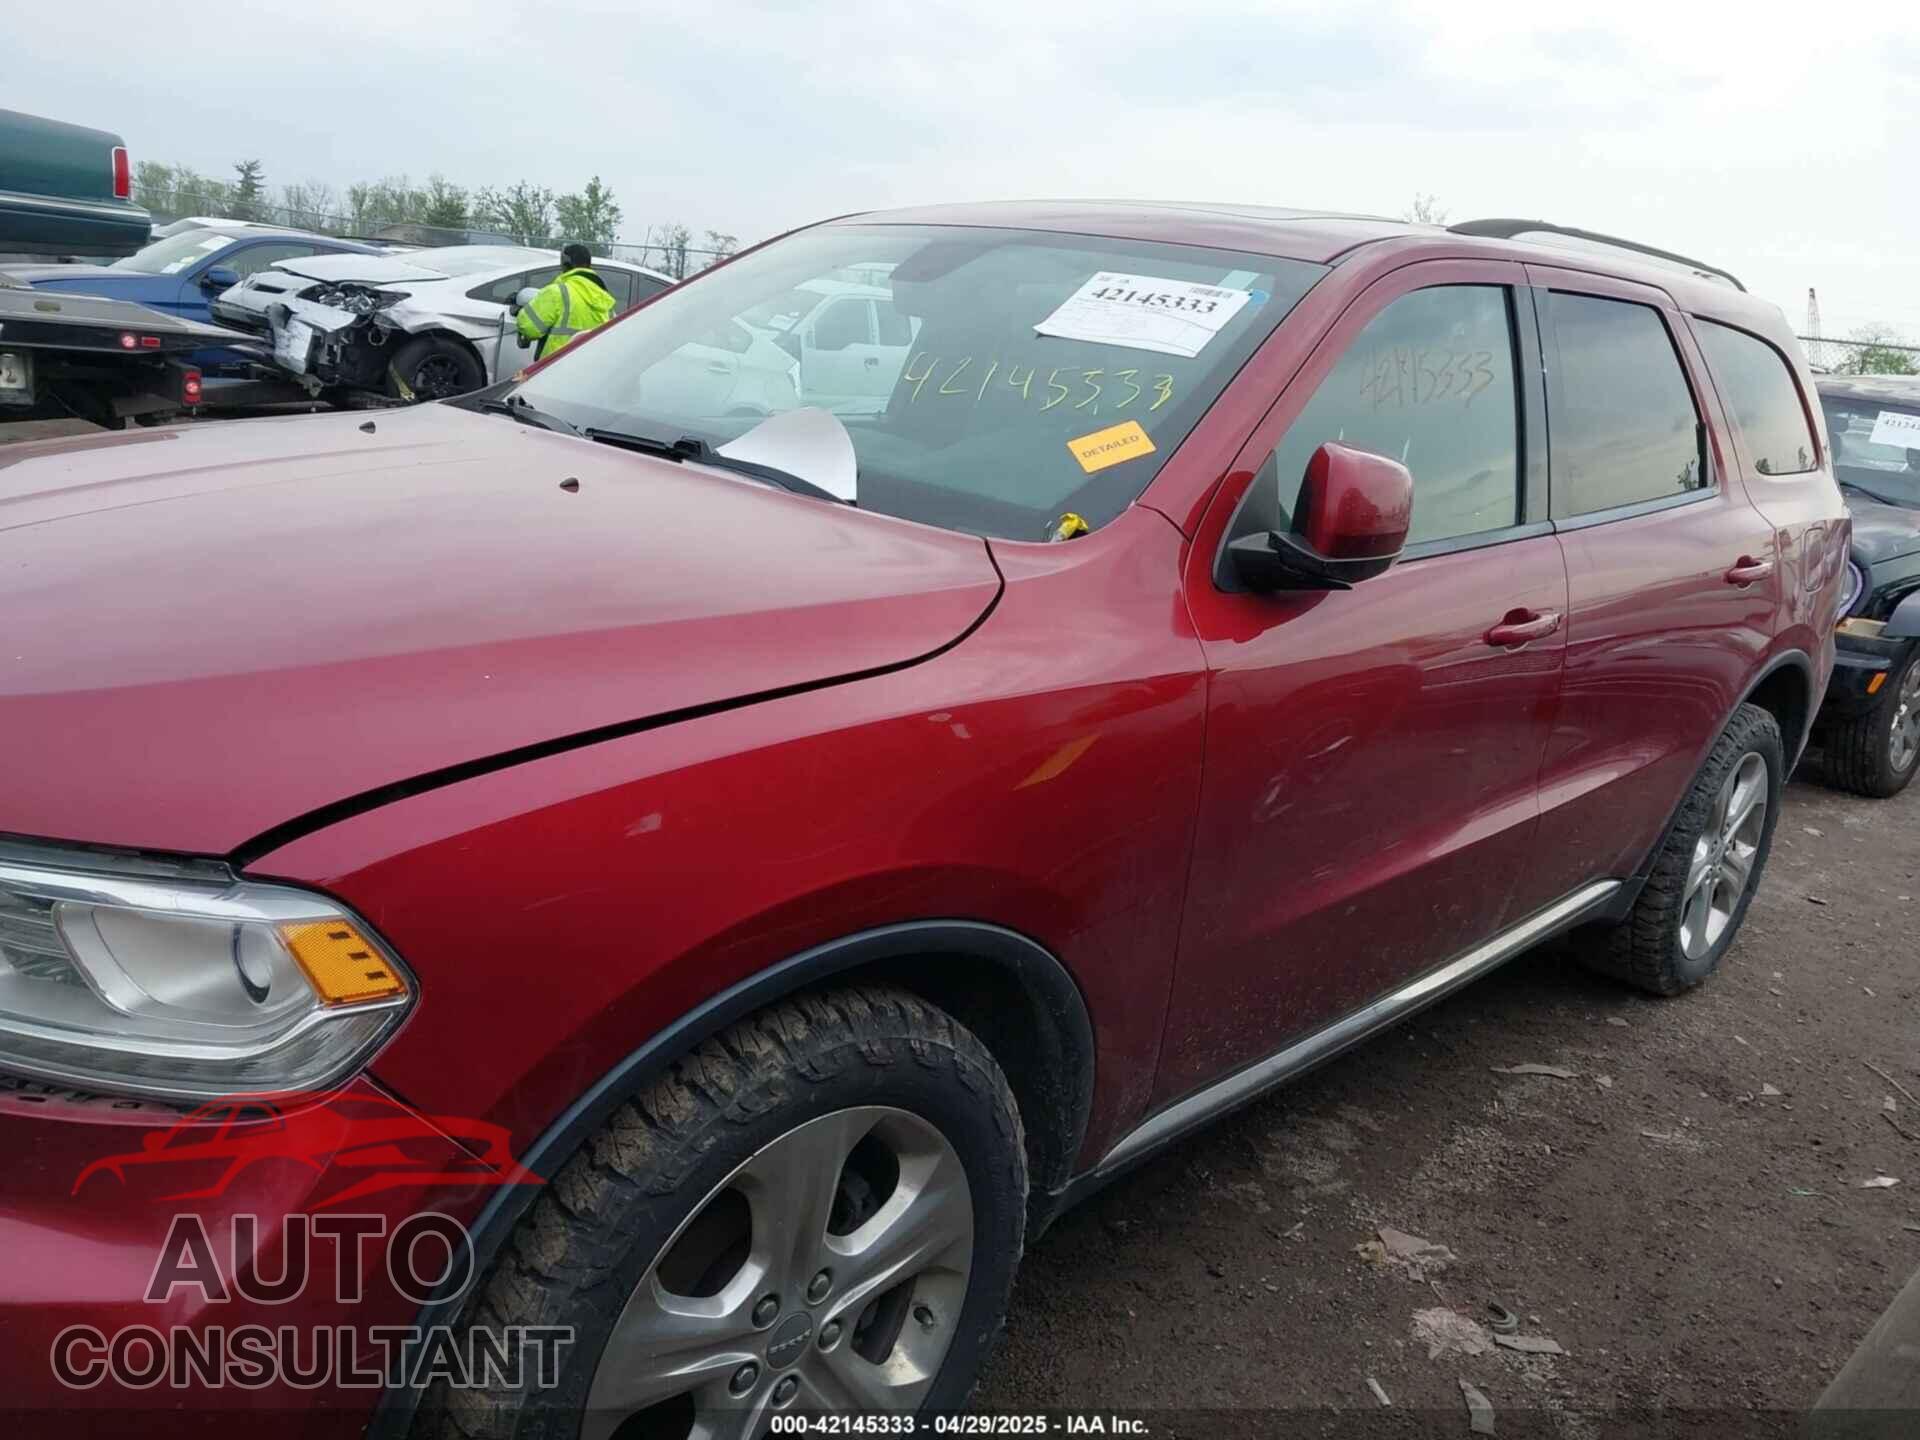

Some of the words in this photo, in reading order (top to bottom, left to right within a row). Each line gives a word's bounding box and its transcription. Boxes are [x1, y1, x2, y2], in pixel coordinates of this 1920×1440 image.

[1091, 287, 1218, 314] 42145333
[904, 352, 1175, 412] 42145333
[1082, 434, 1140, 460] DETAILED
